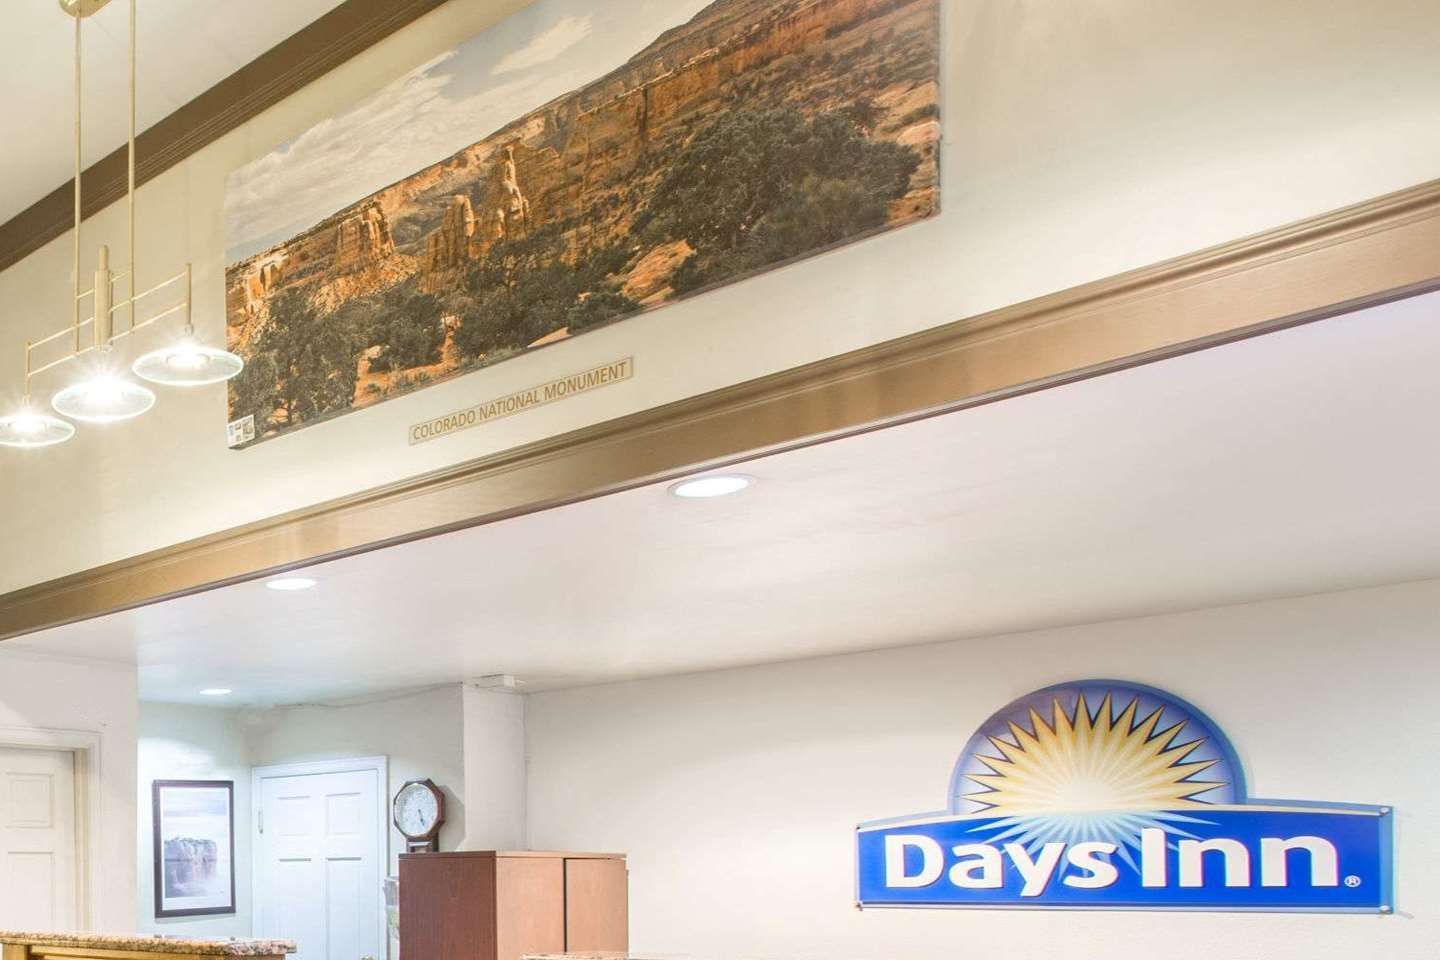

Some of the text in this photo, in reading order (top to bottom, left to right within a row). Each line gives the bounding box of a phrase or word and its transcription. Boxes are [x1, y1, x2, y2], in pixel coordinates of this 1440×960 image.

[413, 362, 627, 440] COLORADO NATIONAL MONUMENT
